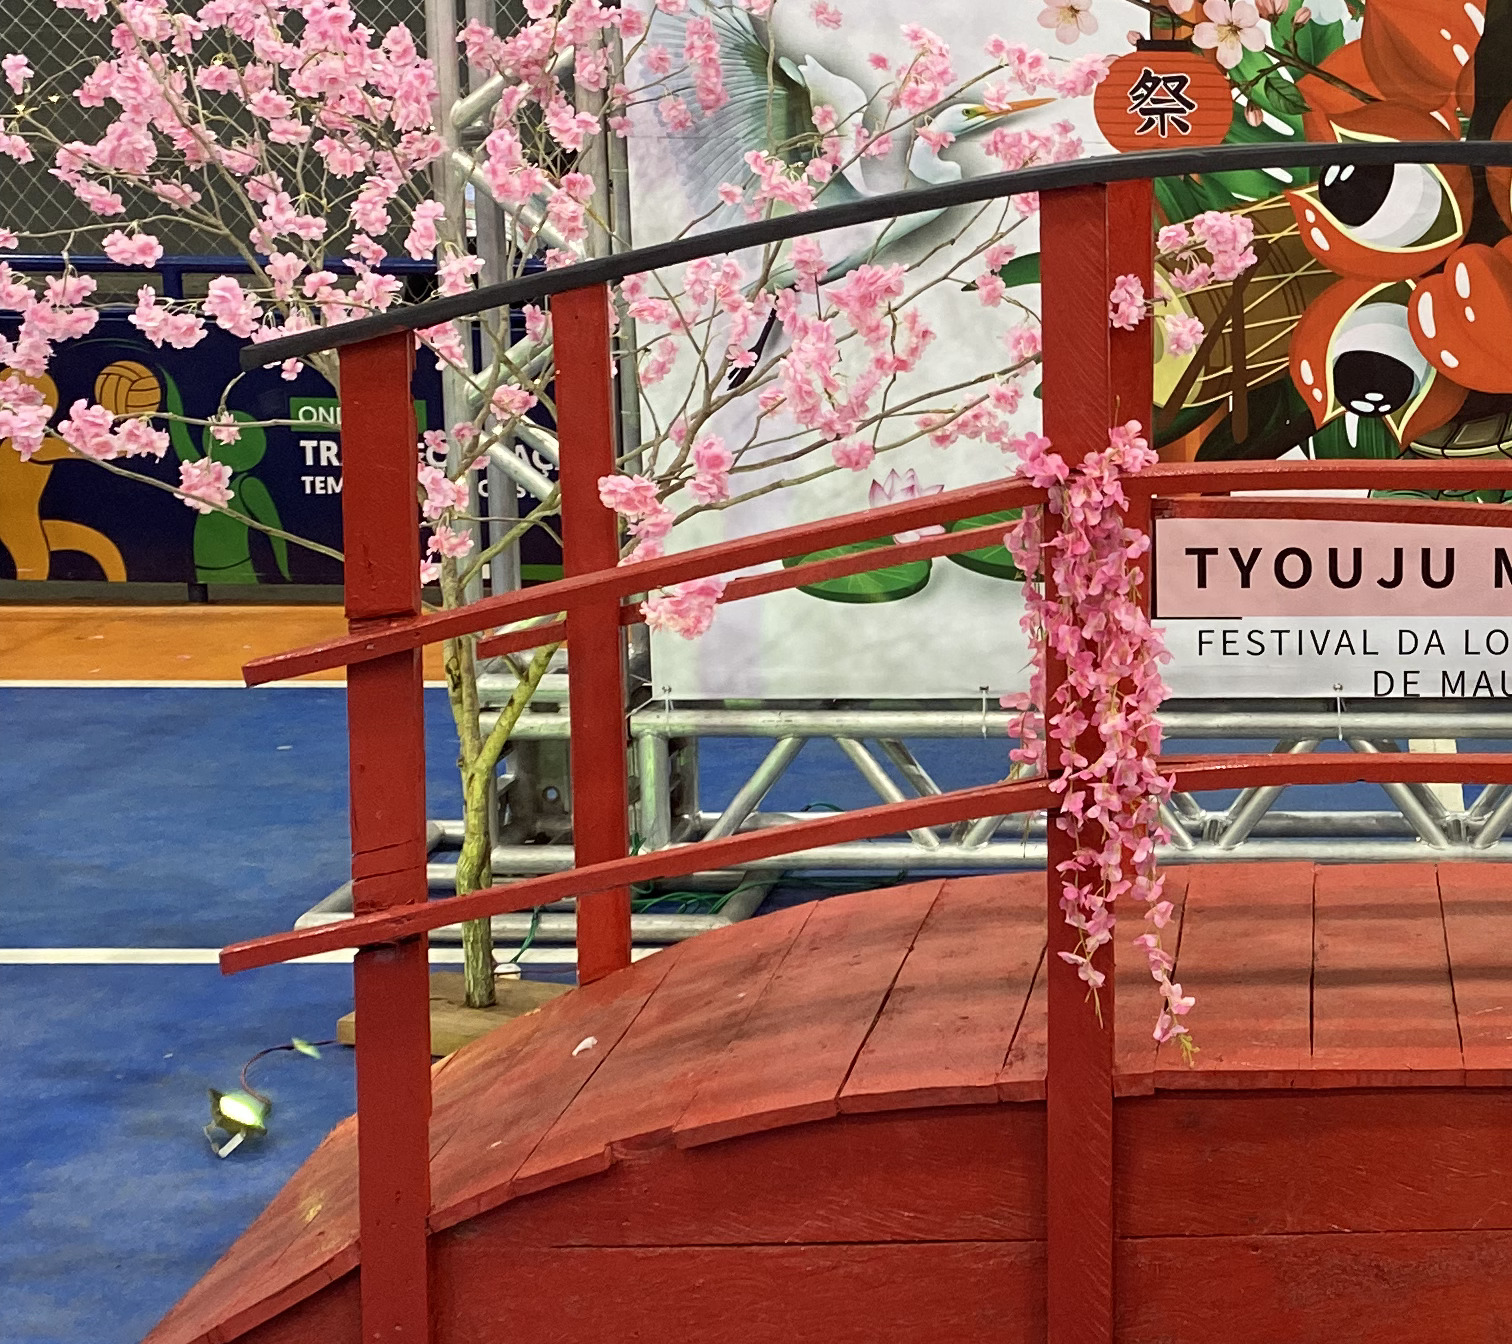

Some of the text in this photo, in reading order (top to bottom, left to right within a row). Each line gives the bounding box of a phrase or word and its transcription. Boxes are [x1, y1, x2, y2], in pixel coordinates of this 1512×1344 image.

[1128, 67, 1197, 138] 祭
[1184, 546, 1456, 590] TYOUJU
[1197, 629, 1379, 656] FESTIVAL
[1398, 629, 1446, 656] DA
[1374, 670, 1421, 698] DE
